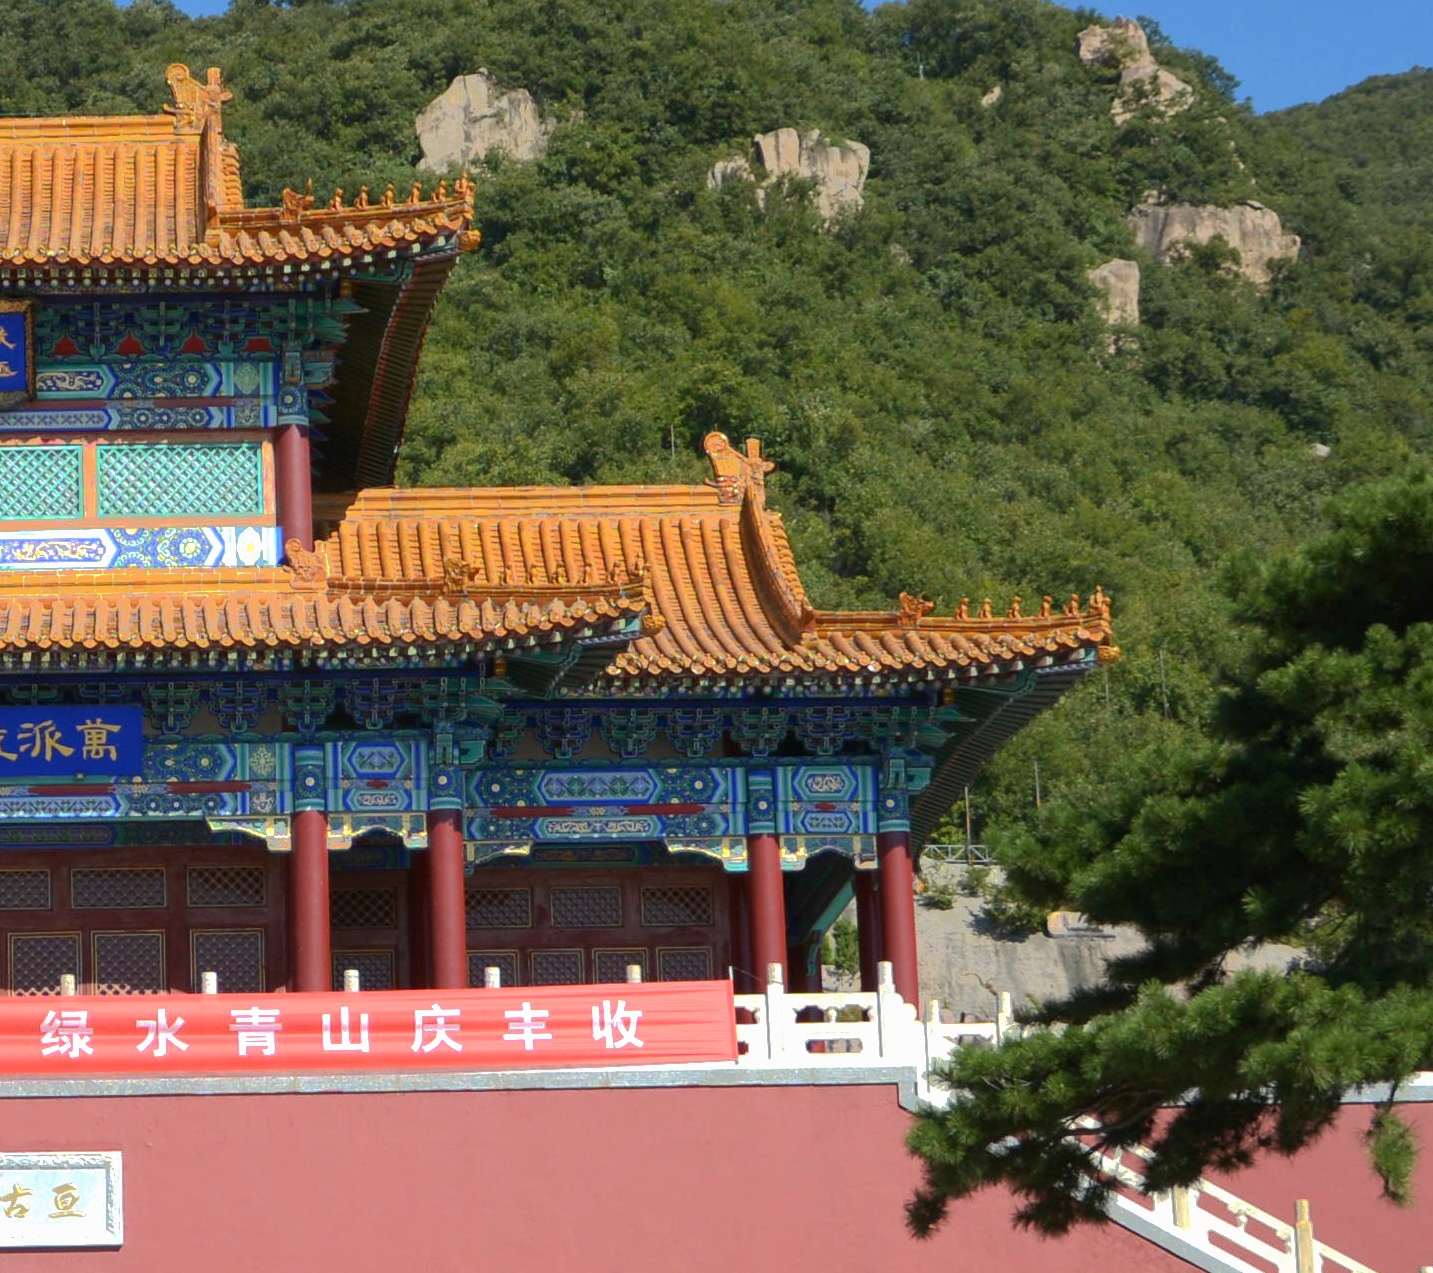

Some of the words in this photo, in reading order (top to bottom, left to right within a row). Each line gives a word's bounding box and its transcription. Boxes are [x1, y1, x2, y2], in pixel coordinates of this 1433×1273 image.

[39, 999, 645, 1059] 绿水青山庆丰收
